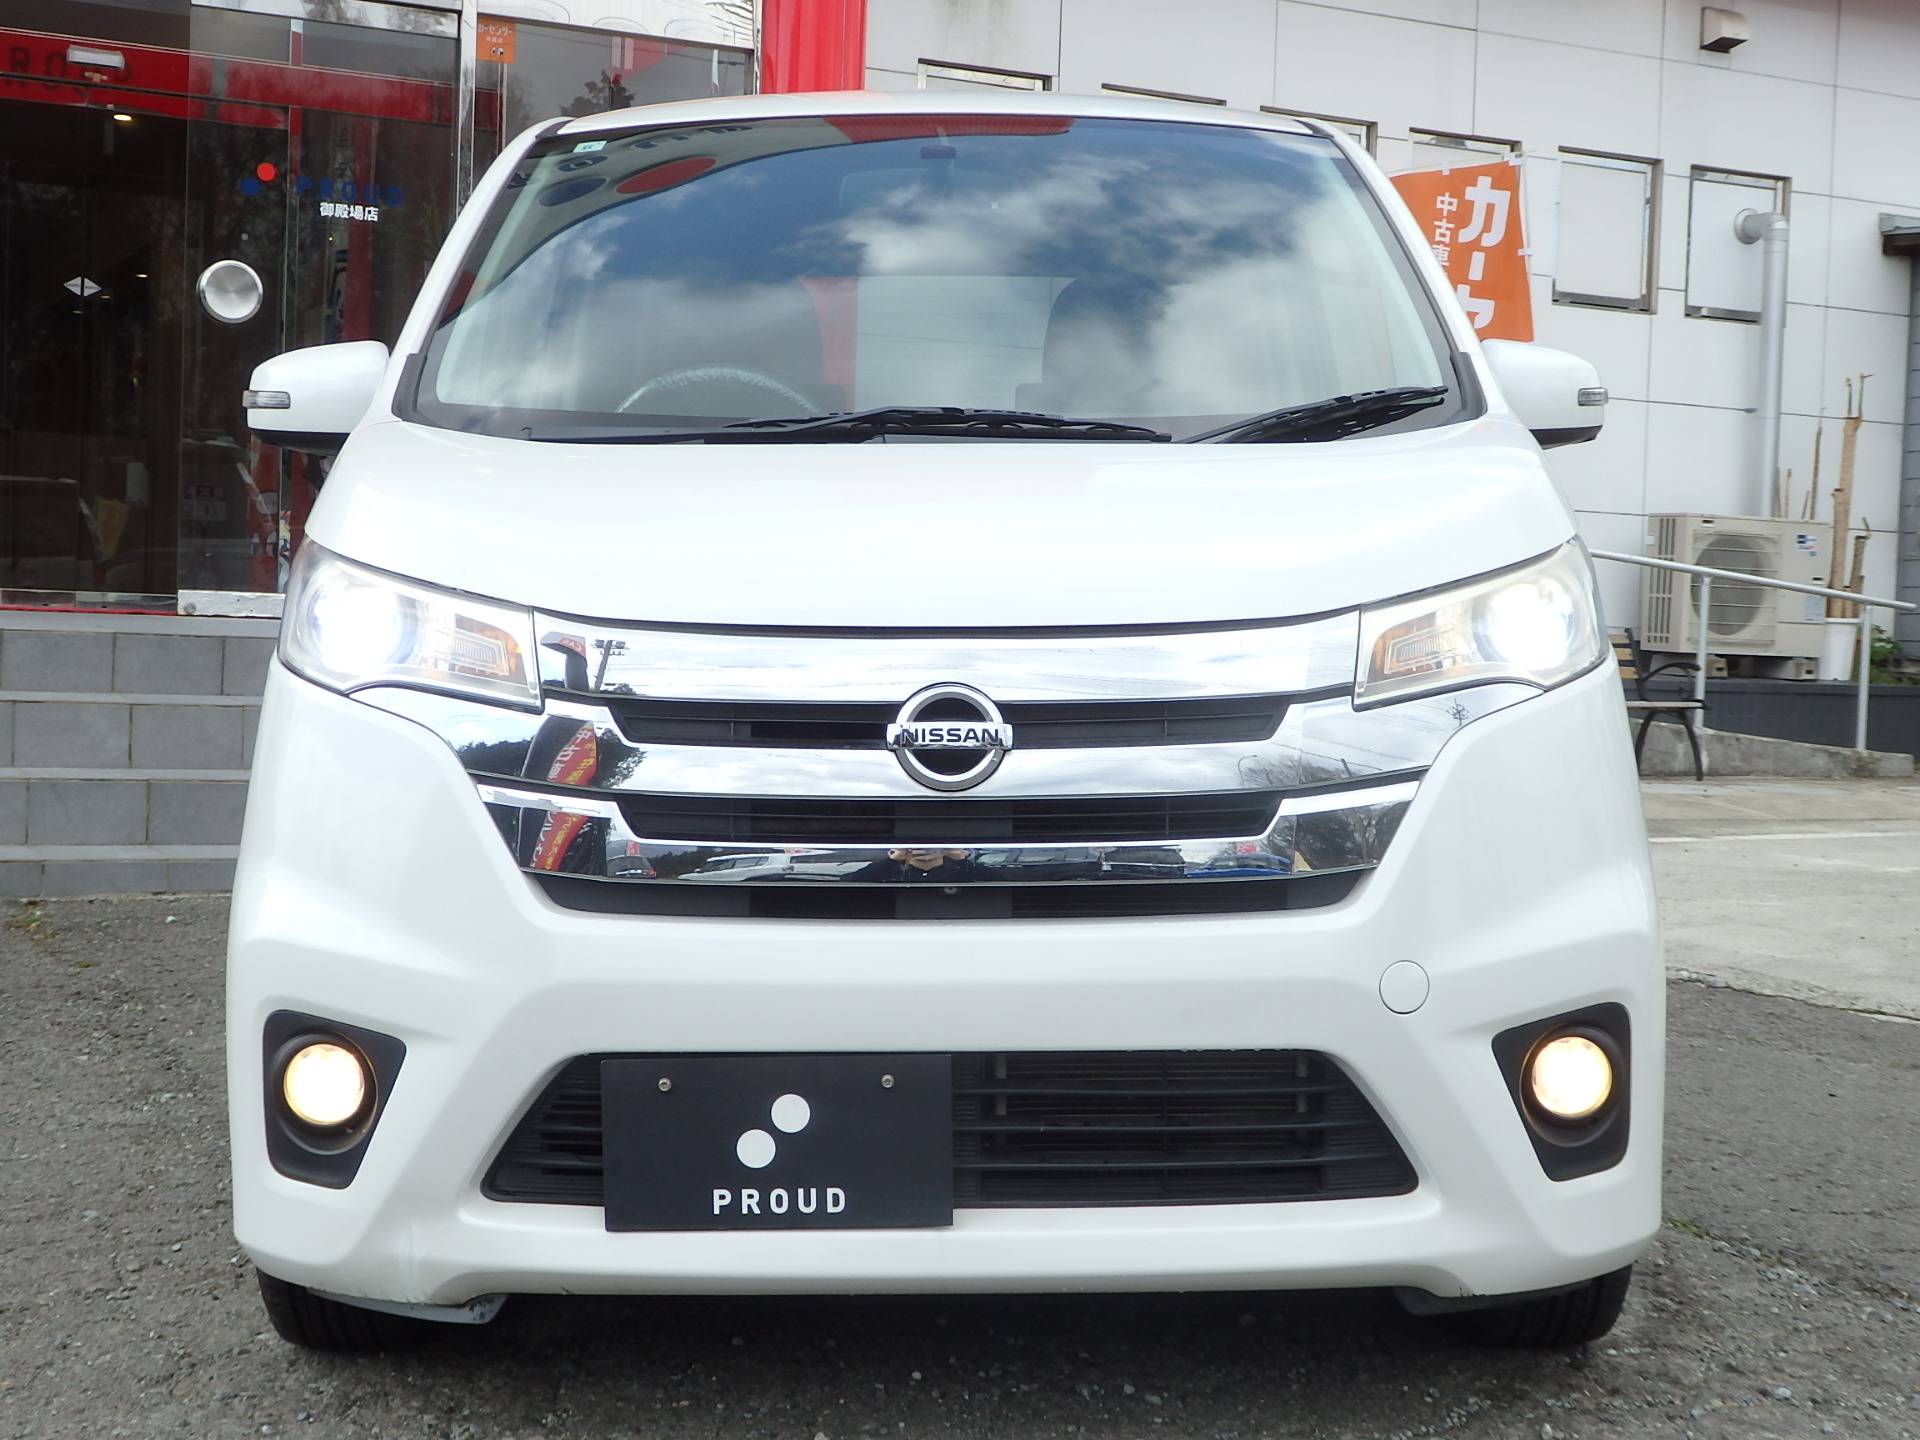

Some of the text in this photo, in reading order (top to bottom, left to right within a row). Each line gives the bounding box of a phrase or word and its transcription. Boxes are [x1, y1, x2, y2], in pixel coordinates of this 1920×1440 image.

[296, 176, 404, 207] PROUD
[320, 202, 379, 222] 御殿場店
[901, 728, 1000, 744] NISSAN
[712, 1187, 847, 1215] PROUD
